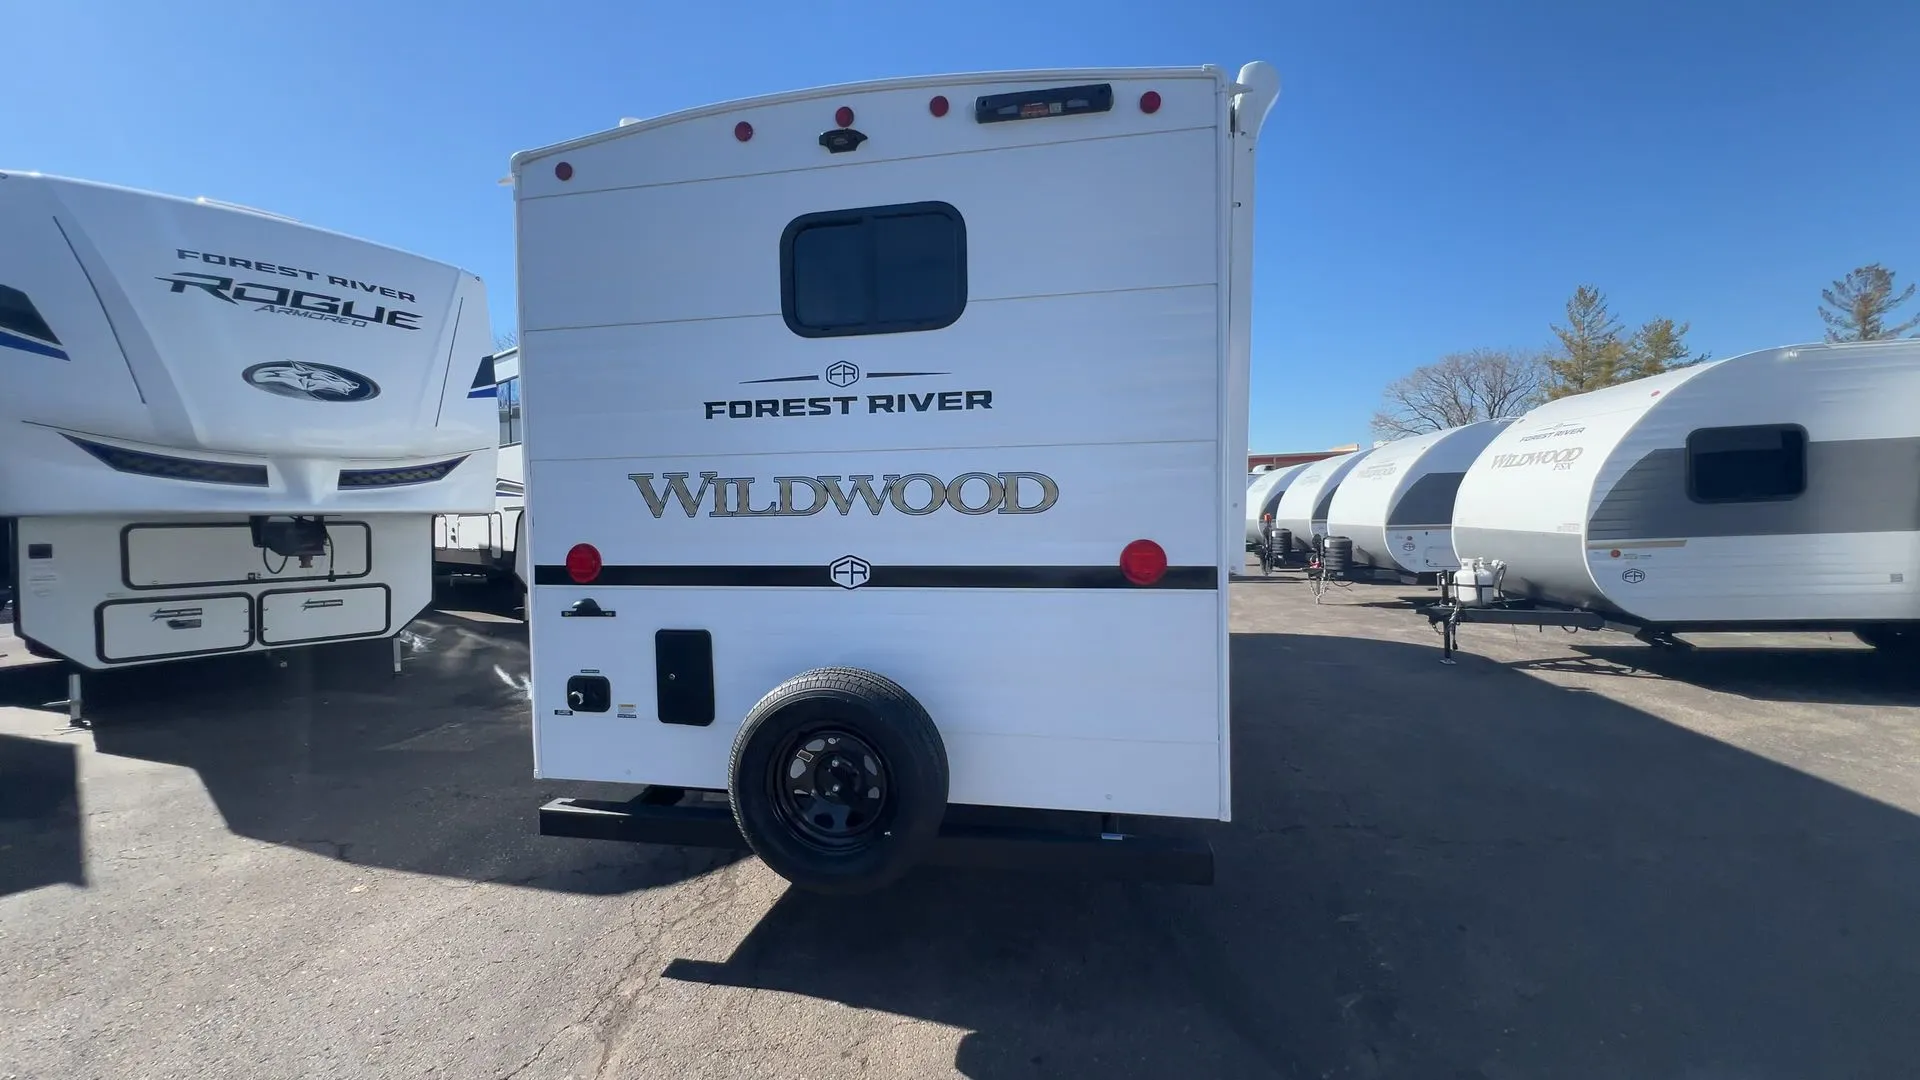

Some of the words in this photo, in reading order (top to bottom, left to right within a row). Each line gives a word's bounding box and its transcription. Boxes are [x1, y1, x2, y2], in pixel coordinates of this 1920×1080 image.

[176, 249, 319, 281] FOREST
[326, 275, 416, 303] RIVER
[154, 272, 423, 330] ROGUE
[254, 305, 368, 328] ARMORED
[703, 396, 858, 420] FOREST
[866, 390, 993, 414] RIVER
[1519, 432, 1555, 443] FOREST
[1554, 427, 1586, 438] RIVER
[1491, 446, 1584, 470] WILDWOOD
[1553, 462, 1575, 471] FSX
[628, 471, 1059, 518] WILDWOOD
